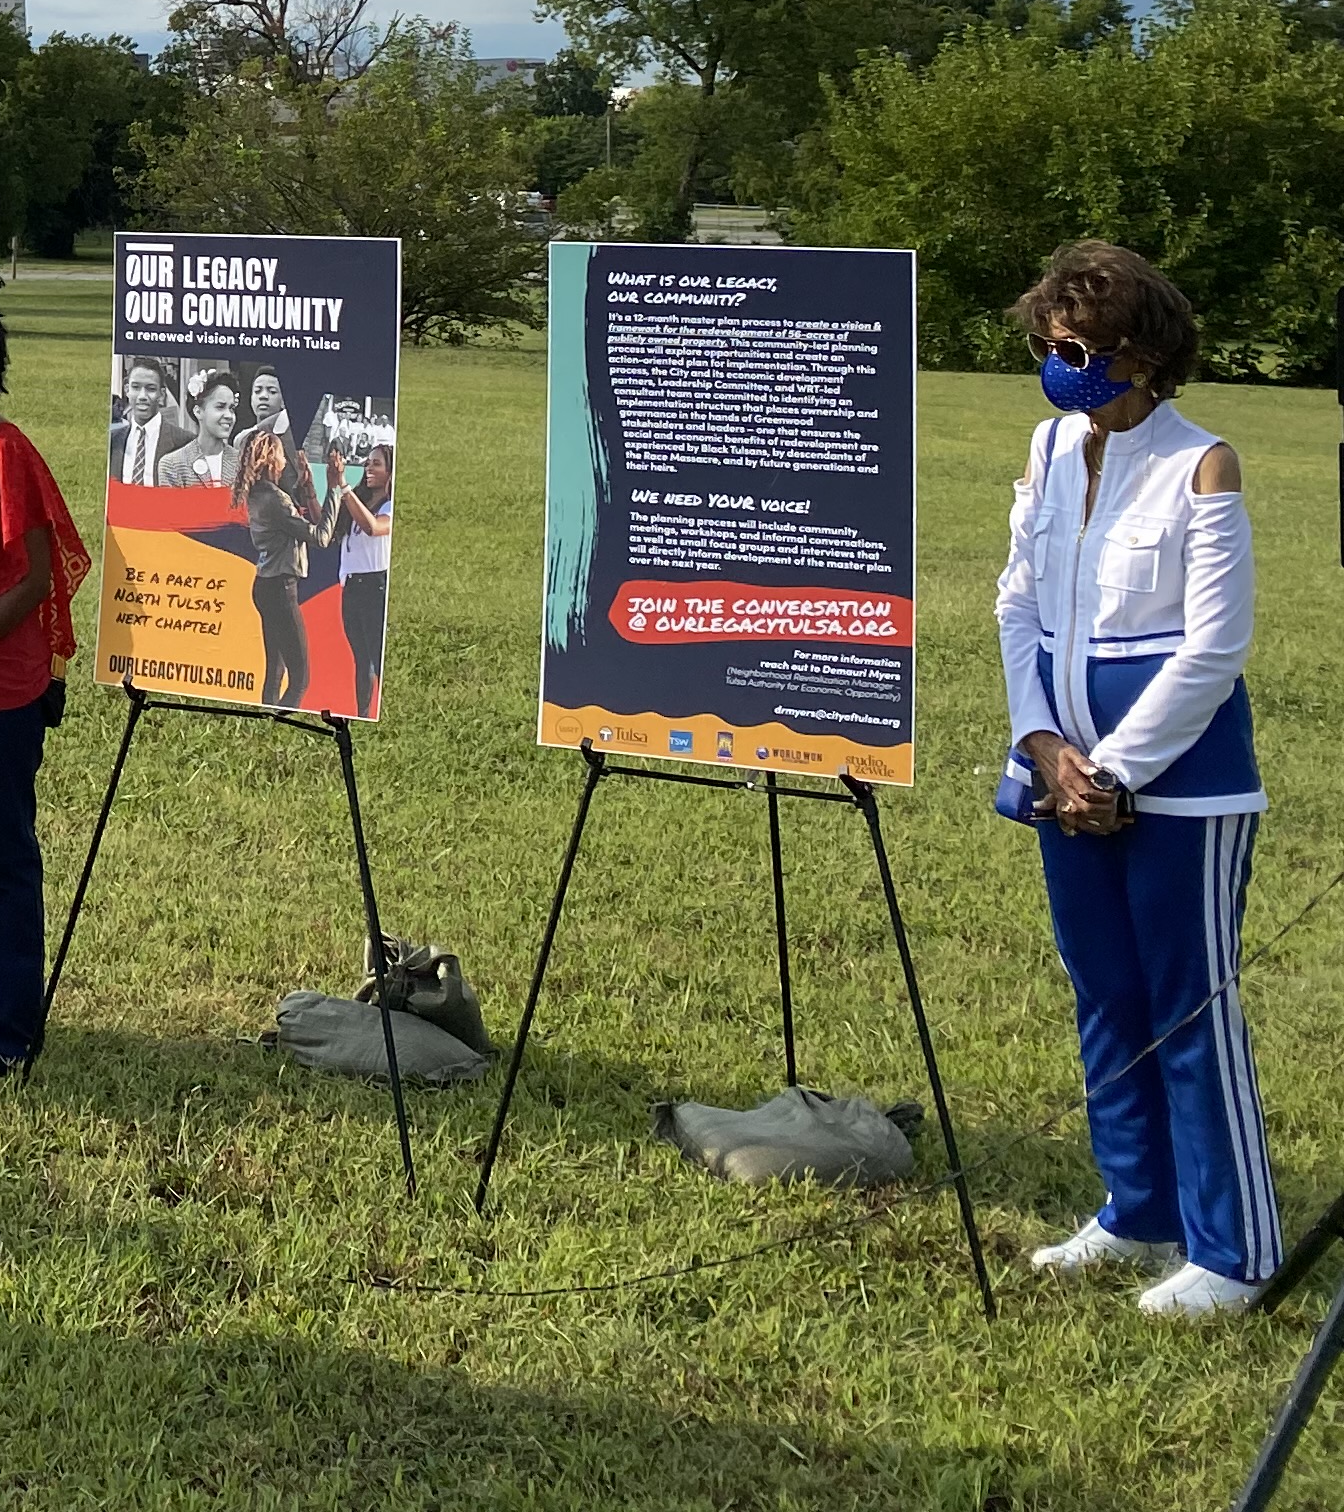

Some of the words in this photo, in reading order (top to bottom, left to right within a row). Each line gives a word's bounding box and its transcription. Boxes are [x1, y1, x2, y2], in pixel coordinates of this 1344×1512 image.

[125, 254, 174, 288] OUR
[182, 255, 287, 295] LEGACY,
[607, 271, 656, 286] WHAT
[659, 274, 676, 286] IS
[678, 275, 711, 288] OUR
[715, 276, 777, 292] LEGACY,
[607, 290, 639, 303] OUR
[643, 291, 746, 306] COMMUNITY?
[125, 290, 174, 324] OUR
[182, 292, 343, 332] COMMUNITY
[608, 312, 623, 321] It's
[680, 316, 716, 324] master
[716, 316, 740, 328] plan
[741, 319, 781, 328] process
[782, 318, 794, 327] to
[795, 320, 831, 330] create
[830, 322, 840, 330] a
[839, 320, 873, 331] vision
[125, 332, 134, 340] a
[137, 330, 193, 343] renewed
[196, 333, 236, 346] vision
[239, 332, 259, 346] for
[262, 335, 300, 349] North
[304, 336, 340, 350] Tulsa
[607, 345, 645, 354] process
[646, 345, 663, 354] will
[664, 346, 702, 358] explore
[703, 349, 771, 360] opportunities
[772, 351, 793, 359] and
[794, 352, 829, 361] create
[830, 354, 845, 362] an
[625, 449, 642, 459] the
[643, 450, 668, 461] Race
[669, 452, 721, 465] Massacre,
[722, 456, 743, 465] and
[744, 456, 758, 468] by
[759, 457, 791, 468] future
[792, 462, 855, 472] generations
[856, 464, 878, 474] and
[625, 460, 649, 470] their
[650, 461, 677, 472] heirs.
[631, 489, 659, 504] WE
[663, 492, 702, 506] NEED
[708, 494, 755, 510] YOUR
[760, 499, 810, 514] VOICE!
[629, 511, 649, 522] The
[650, 513, 695, 527] planning
[696, 518, 739, 528] process
[738, 519, 756, 529] will
[757, 520, 797, 532] include
[798, 525, 858, 538] community
[629, 523, 679, 536] meetings,
[679, 526, 737, 540] workshops,
[739, 531, 760, 540] and
[761, 531, 807, 543] informal
[808, 537, 886, 551] conversations,
[642, 534, 663, 544] well
[664, 537, 677, 545] as
[679, 537, 707, 547] small
[708, 538, 737, 549] focus
[738, 543, 775, 554] groups
[777, 544, 798, 554] and
[800, 545, 855, 558] interviews
[856, 549, 879, 560] that
[628, 544, 646, 553] will
[647, 544, 686, 558] directly
[687, 547, 722, 559] inform
[723, 550, 791, 564] development
[793, 556, 805, 565] of
[806, 557, 825, 567] the
[826, 560, 865, 570] master
[866, 561, 891, 573] plan
[628, 556, 652, 565] over
[652, 556, 670, 566] the
[671, 558, 694, 568] next
[695, 561, 721, 571] year.
[125, 568, 146, 582] BE
[150, 572, 160, 584] A
[166, 574, 203, 588] PART
[206, 578, 227, 590] OF
[114, 588, 161, 606] NORTH
[167, 594, 225, 613] TULSA'S
[627, 598, 677, 614] JOIN
[684, 597, 724, 615] THE
[732, 599, 891, 617] CONVERSATION
[116, 612, 152, 627] NEXT
[155, 618, 222, 636] CHAPTER!
[628, 613, 647, 631] @
[655, 616, 898, 636] OURLEGACYTULSA.ORG
[793, 649, 813, 660] For
[810, 653, 839, 662] more
[839, 653, 901, 668] information
[109, 655, 255, 691] OURLEGACYTULSA.ORG
[759, 661, 789, 670] reach
[790, 663, 808, 671] out
[809, 663, 821, 673] to
[868, 669, 900, 681] Myers
[614, 727, 648, 743] Tulsa
[670, 737, 689, 746] TSW
[846, 754, 884, 767] studio
